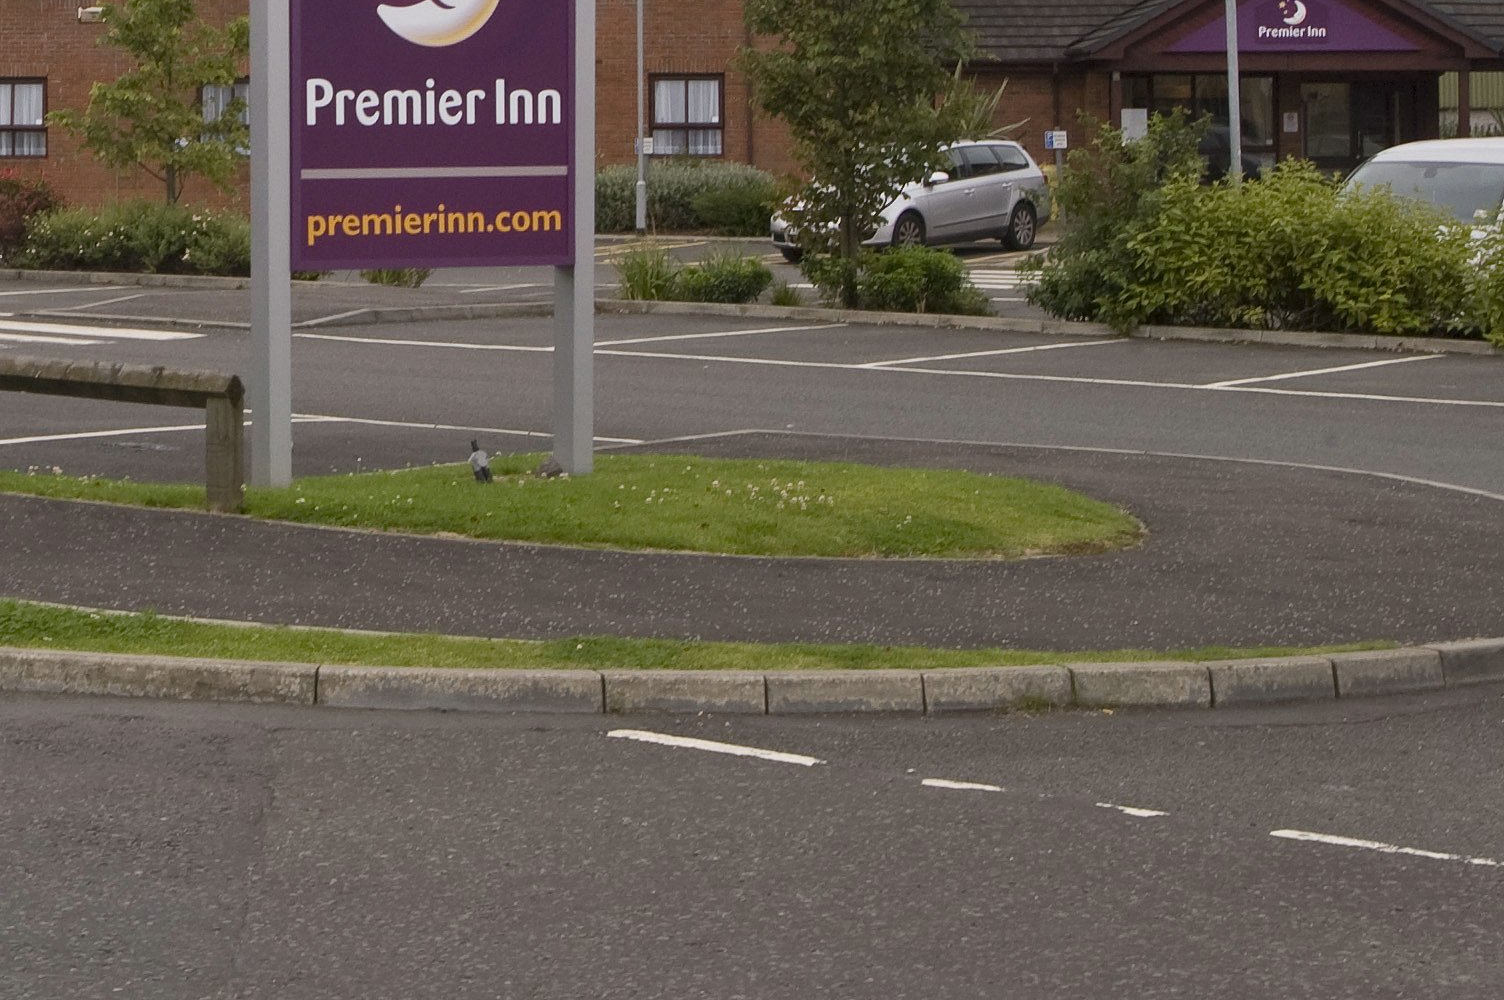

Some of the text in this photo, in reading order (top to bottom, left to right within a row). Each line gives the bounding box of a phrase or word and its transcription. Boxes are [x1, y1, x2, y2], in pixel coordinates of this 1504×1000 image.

[1258, 25, 1326, 37] Premier Inn
[306, 78, 562, 126] Premier Inn
[307, 203, 562, 246] premierinn.com
